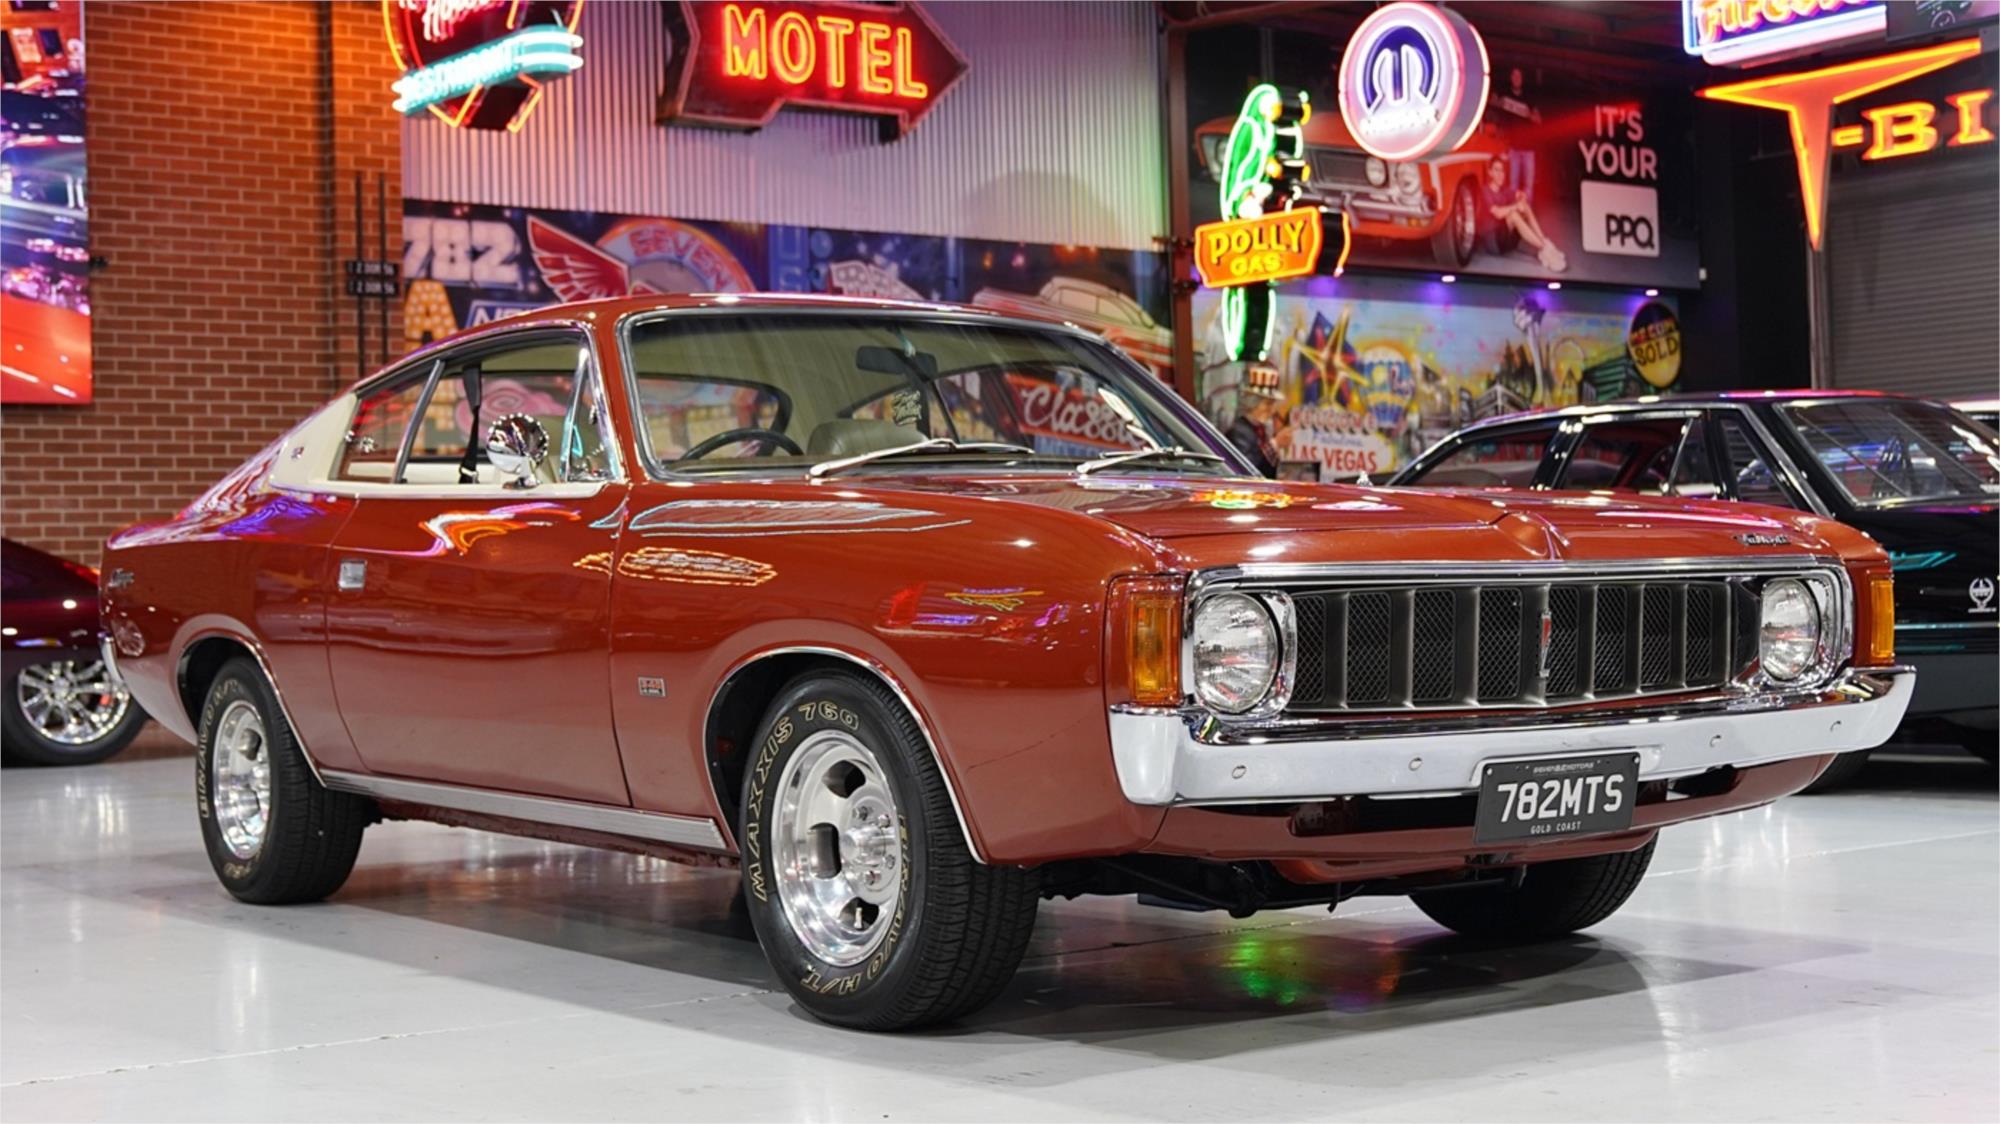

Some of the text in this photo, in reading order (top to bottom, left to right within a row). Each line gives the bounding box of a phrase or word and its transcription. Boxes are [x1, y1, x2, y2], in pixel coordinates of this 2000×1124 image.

[723, 3, 928, 98] MOTEL
[1595, 104, 1644, 142] IT'S
[1578, 139, 1658, 180] YOUR
[402, 217, 521, 287] 782
[1208, 218, 1306, 265] POLLY
[1606, 213, 1655, 250] PPQ
[629, 227, 735, 292] SEVEN
[1230, 252, 1282, 277] GAS
[1635, 336, 1678, 367] SOLD
[1323, 447, 1377, 473] VEGAS
[747, 701, 859, 901] MAXXIS 760
[1497, 774, 1625, 823] 782MTS
[1530, 821, 1582, 834] GOLD COAST
